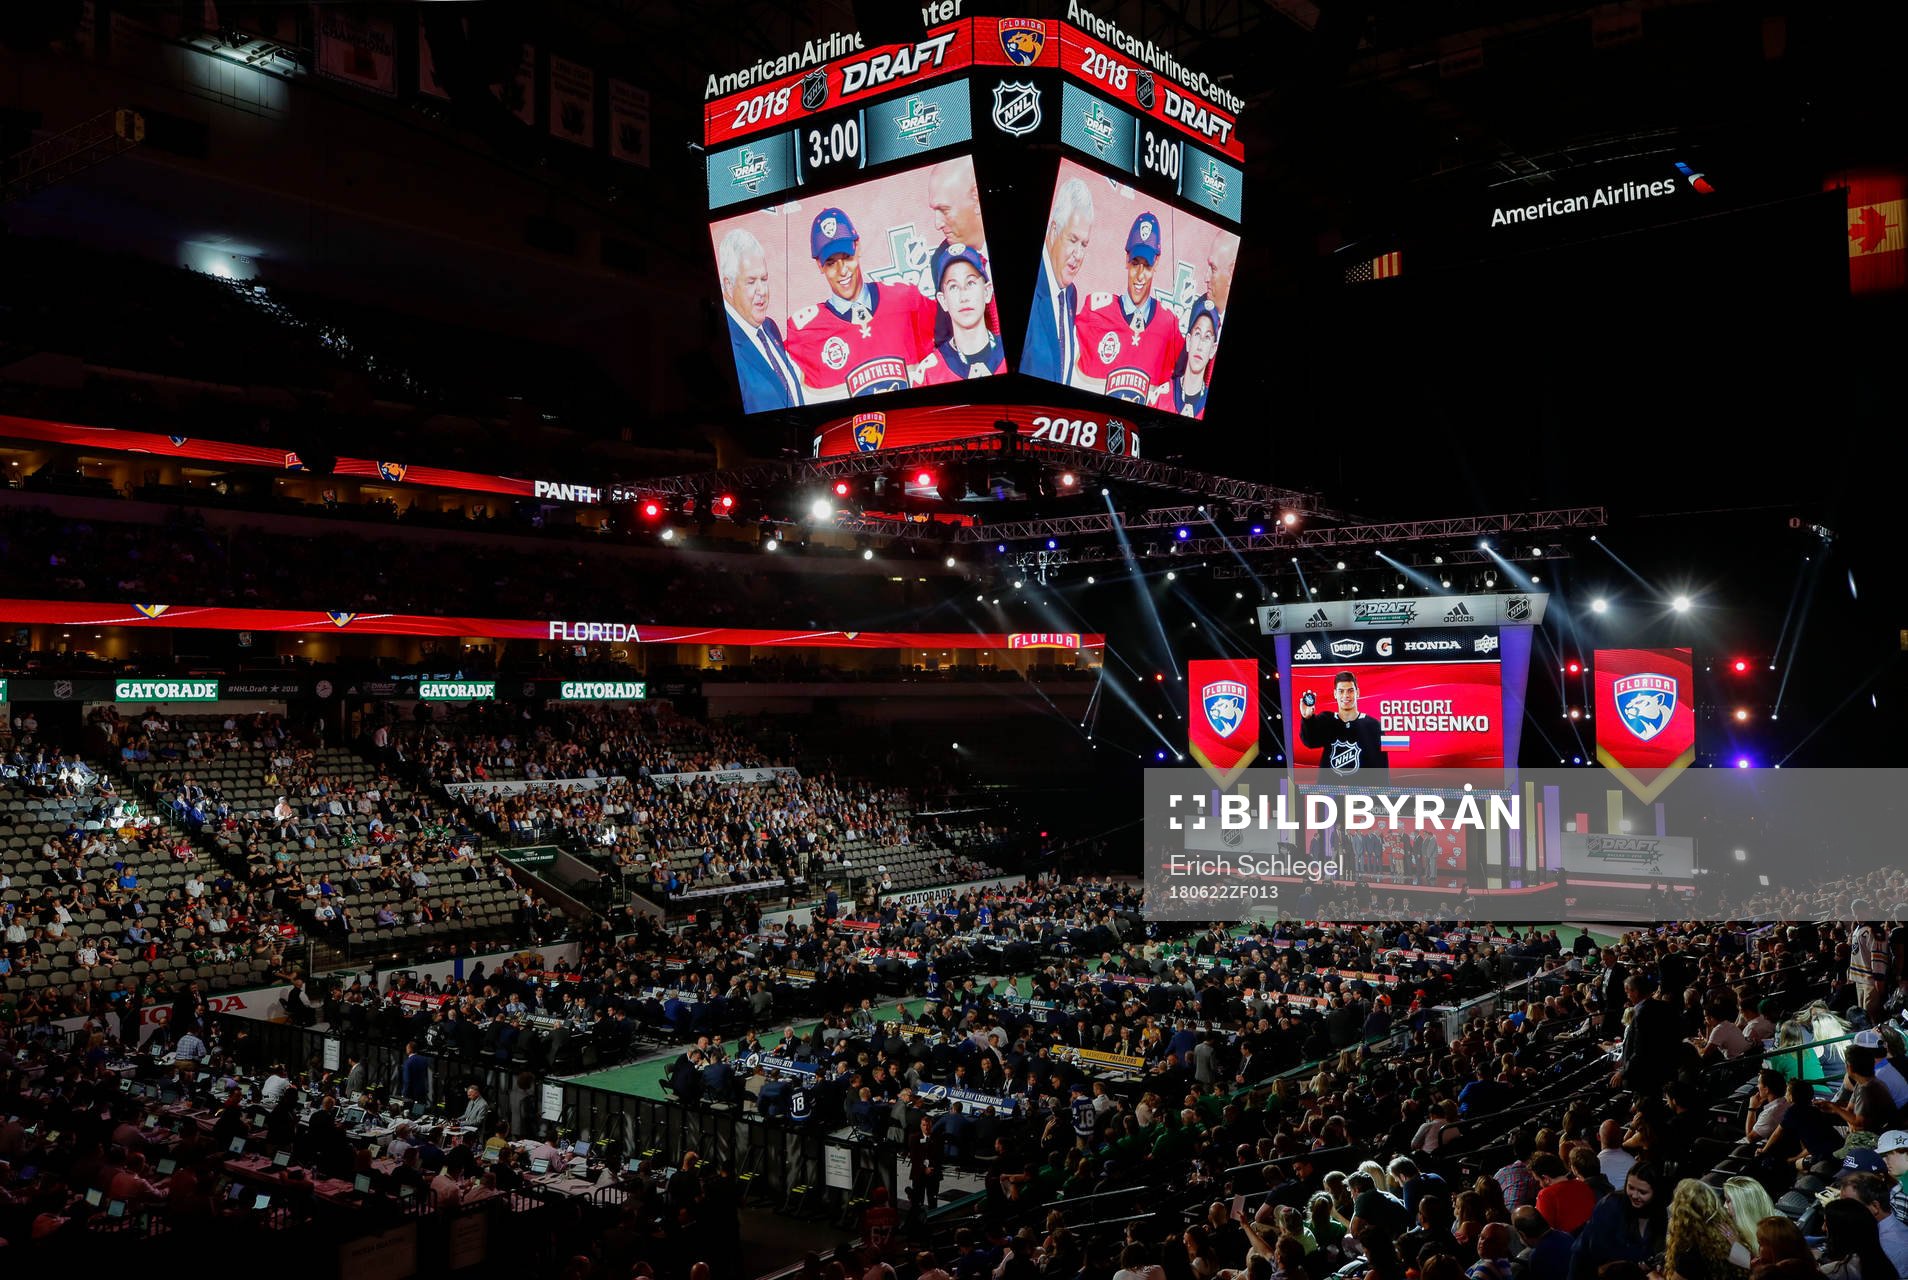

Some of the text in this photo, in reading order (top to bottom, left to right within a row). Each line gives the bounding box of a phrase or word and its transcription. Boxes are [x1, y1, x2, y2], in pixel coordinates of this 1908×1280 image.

[1002, 19, 1043, 31] FLORIDA
[842, 32, 956, 95] DRAFT
[1067, 0, 1245, 114] AmericanAirlinesCenter
[1081, 47, 1129, 91] 2018
[805, 81, 825, 104] NHL
[731, 88, 791, 130] 2018
[1003, 97, 1032, 123] NHL
[1164, 88, 1233, 145] DRAFT
[901, 109, 940, 130] DRAFT
[1086, 118, 1114, 137] DRAFT
[808, 119, 859, 168] 3:00
[1144, 131, 1179, 181] 3:00
[734, 159, 768, 178] DRAFT
[1203, 174, 1227, 193] DRAFT
[1490, 177, 1676, 227] American Airlines
[852, 365, 902, 389] PANTHERS
[1110, 373, 1147, 393] PANTHERS
[854, 412, 885, 423] FLORIDA
[1031, 416, 1098, 448] 2018
[1367, 602, 1415, 613] DRAFT
[1510, 603, 1528, 617] NHL
[1305, 620, 1333, 628] adidas
[1443, 614, 1474, 623] adidas
[548, 620, 642, 643] FLORIDA
[1014, 633, 1075, 648] FLORIDA
[1333, 642, 1363, 654] Denny's
[1376, 637, 1393, 656] G
[1404, 640, 1462, 650] HONDA
[1294, 651, 1322, 660] adidas
[116, 683, 217, 698] GATORADE
[228, 684, 299, 693] #NHLDraft 2018
[419, 683, 495, 698] GATORADE
[562, 682, 645, 699] GATORADE
[1206, 684, 1242, 697] FLORIDA
[1619, 678, 1671, 692] FLORIDA
[1380, 700, 1453, 715] GRIGORI
[1380, 715, 1490, 732] DENISENKO
[1334, 751, 1356, 767] NHL
[1602, 838, 1659, 851] DRAFT
[763, 1056, 794, 1068] WINNIPEG JETS
[1108, 1054, 1137, 1065] PREDATORS
[950, 1089, 965, 1098] TAMPA
[965, 1092, 975, 1100] BAY
[793, 1097, 804, 1113] 18
[1079, 1110, 1095, 1127] 18
